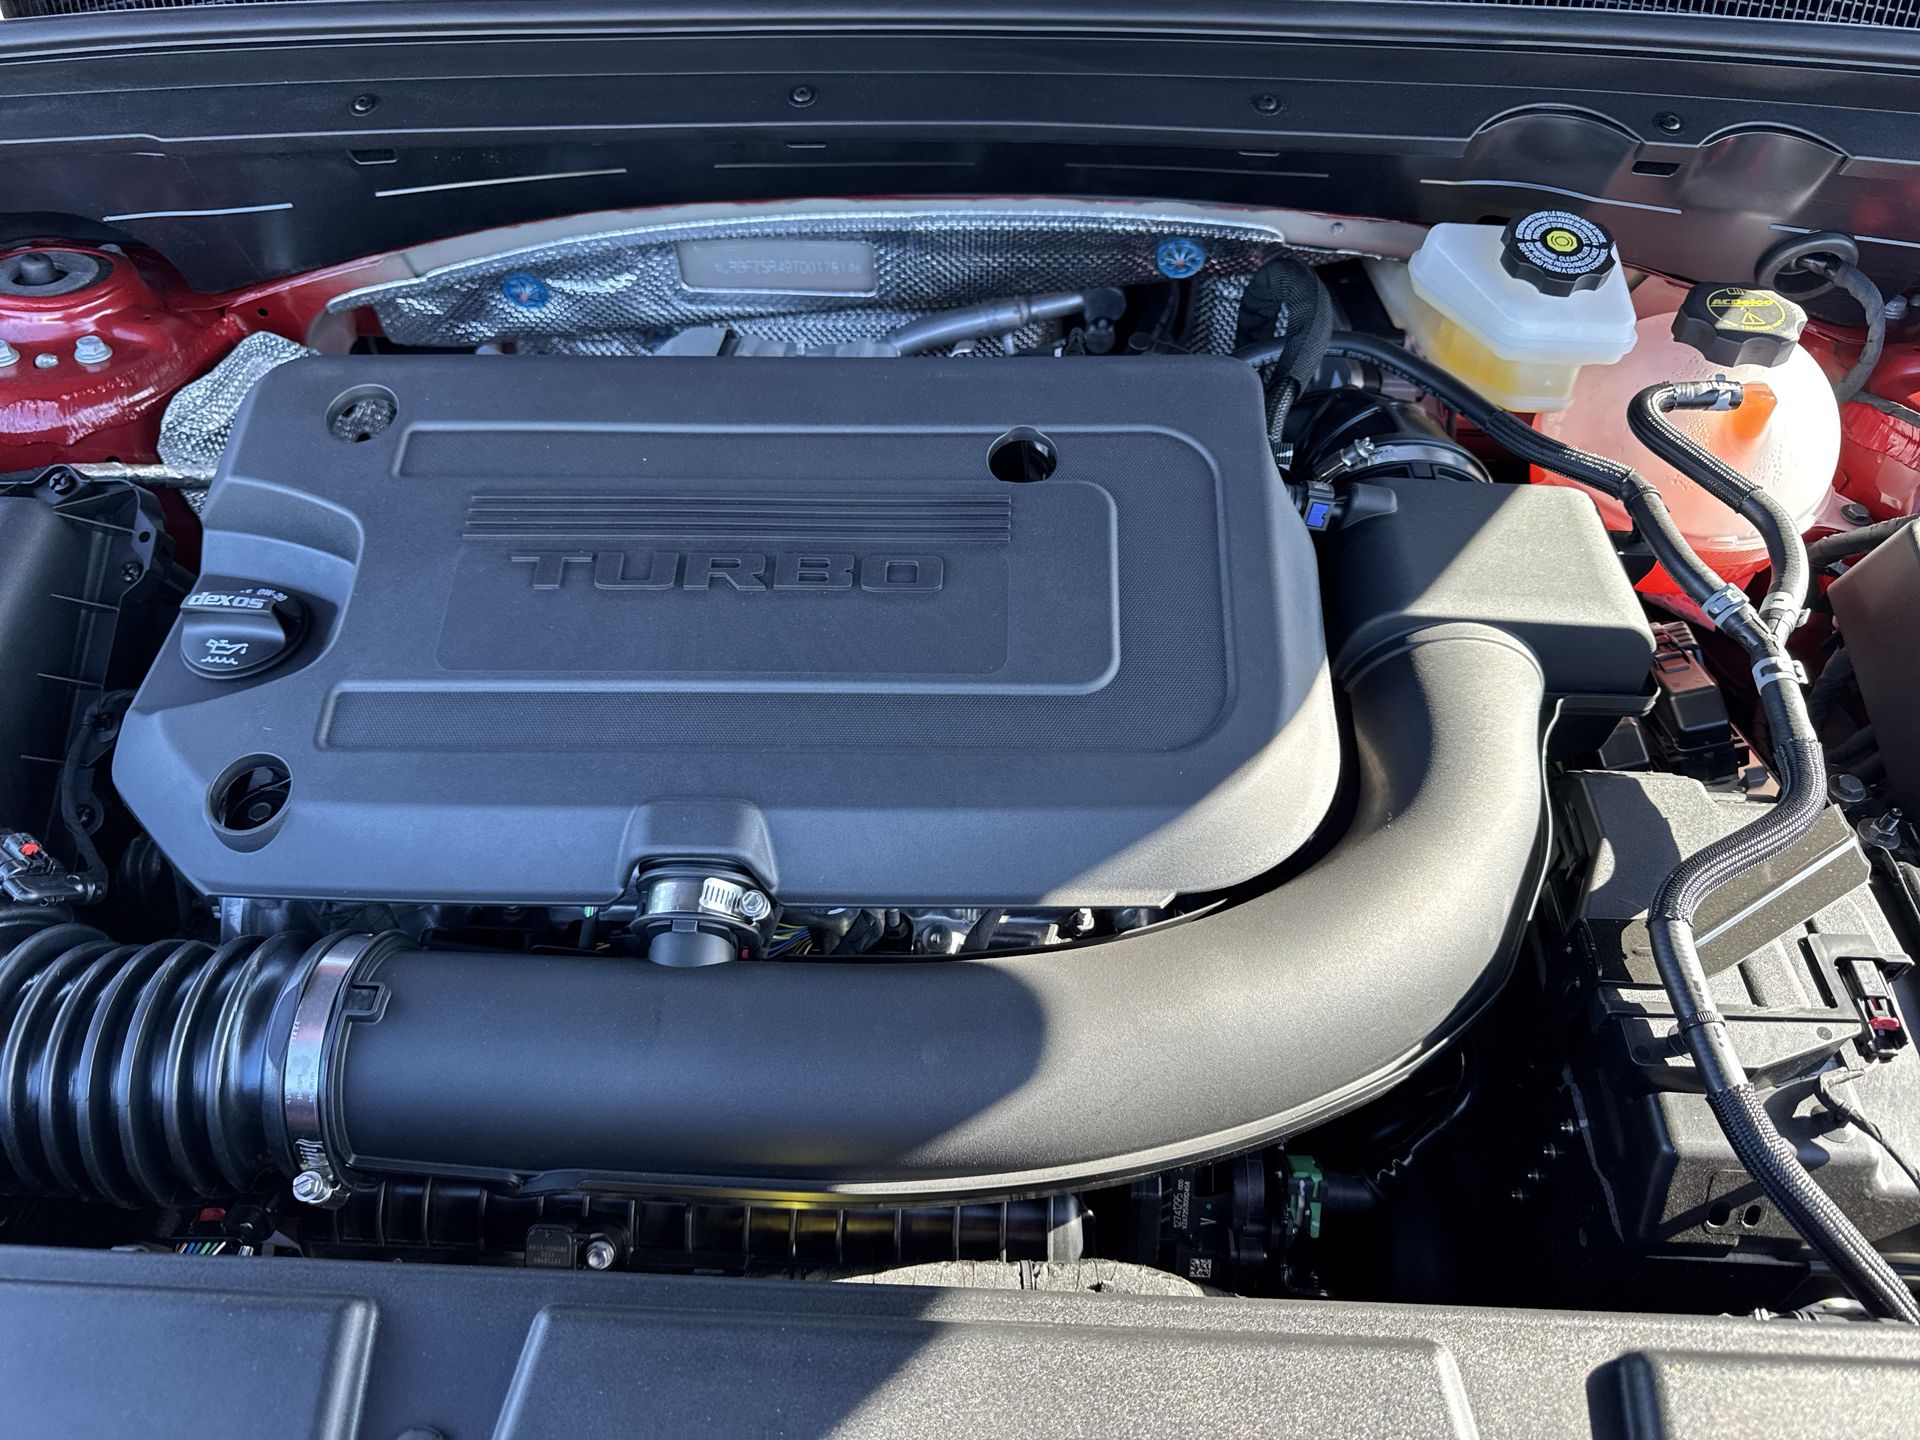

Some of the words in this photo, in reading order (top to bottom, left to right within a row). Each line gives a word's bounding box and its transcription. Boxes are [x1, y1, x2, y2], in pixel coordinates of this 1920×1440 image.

[1542, 262, 1561, 273] FROM
[511, 551, 943, 593] TURBO
[188, 591, 268, 609] dexos
[256, 588, 288, 602] 0W-20
